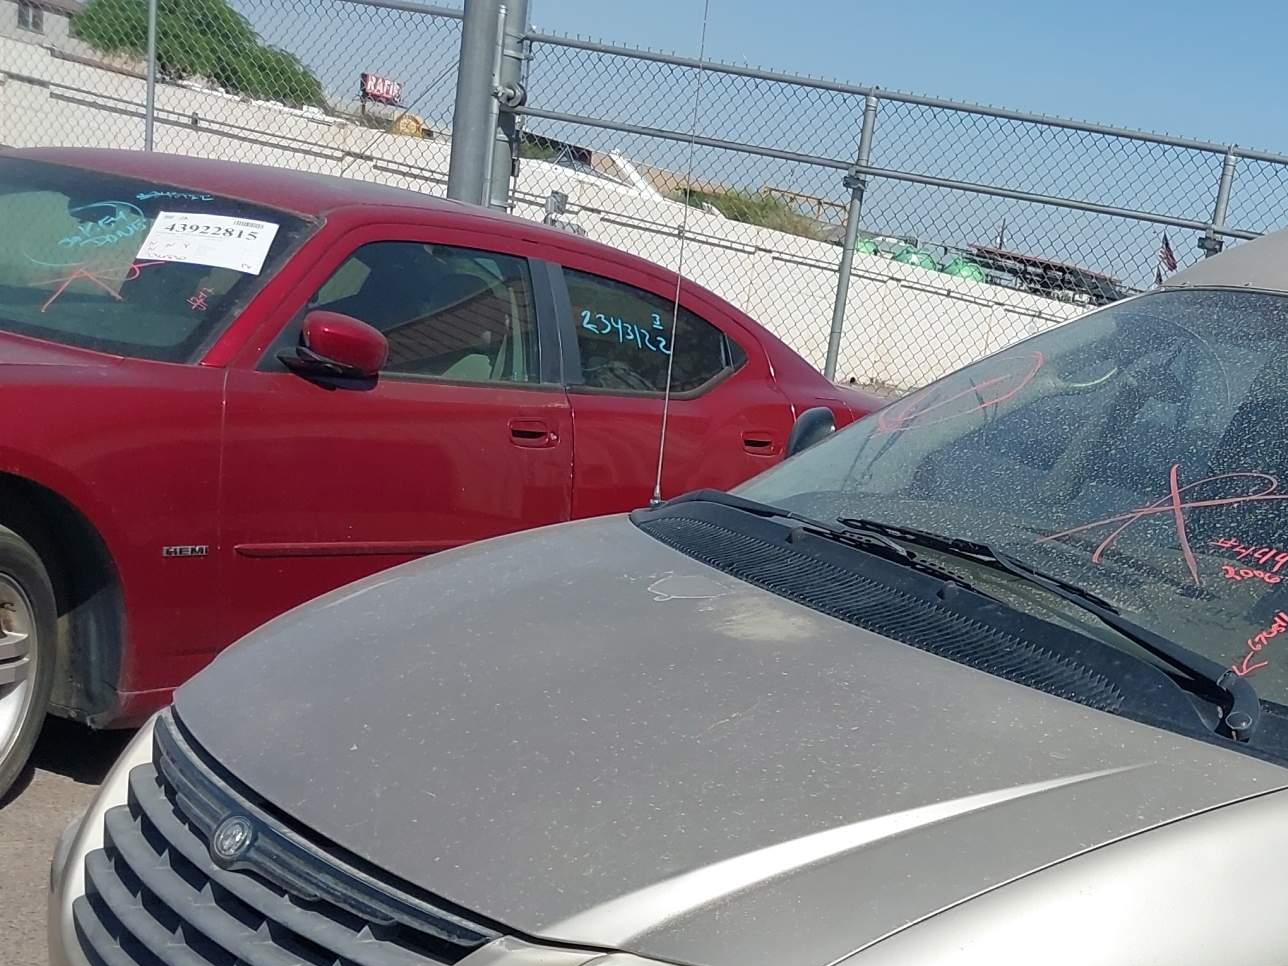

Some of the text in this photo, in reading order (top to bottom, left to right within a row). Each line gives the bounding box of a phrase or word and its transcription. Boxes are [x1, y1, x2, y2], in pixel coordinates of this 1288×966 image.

[163, 222, 259, 241] 43922815
[163, 545, 209, 556] HEMI
[1222, 565, 1281, 584] 2006
